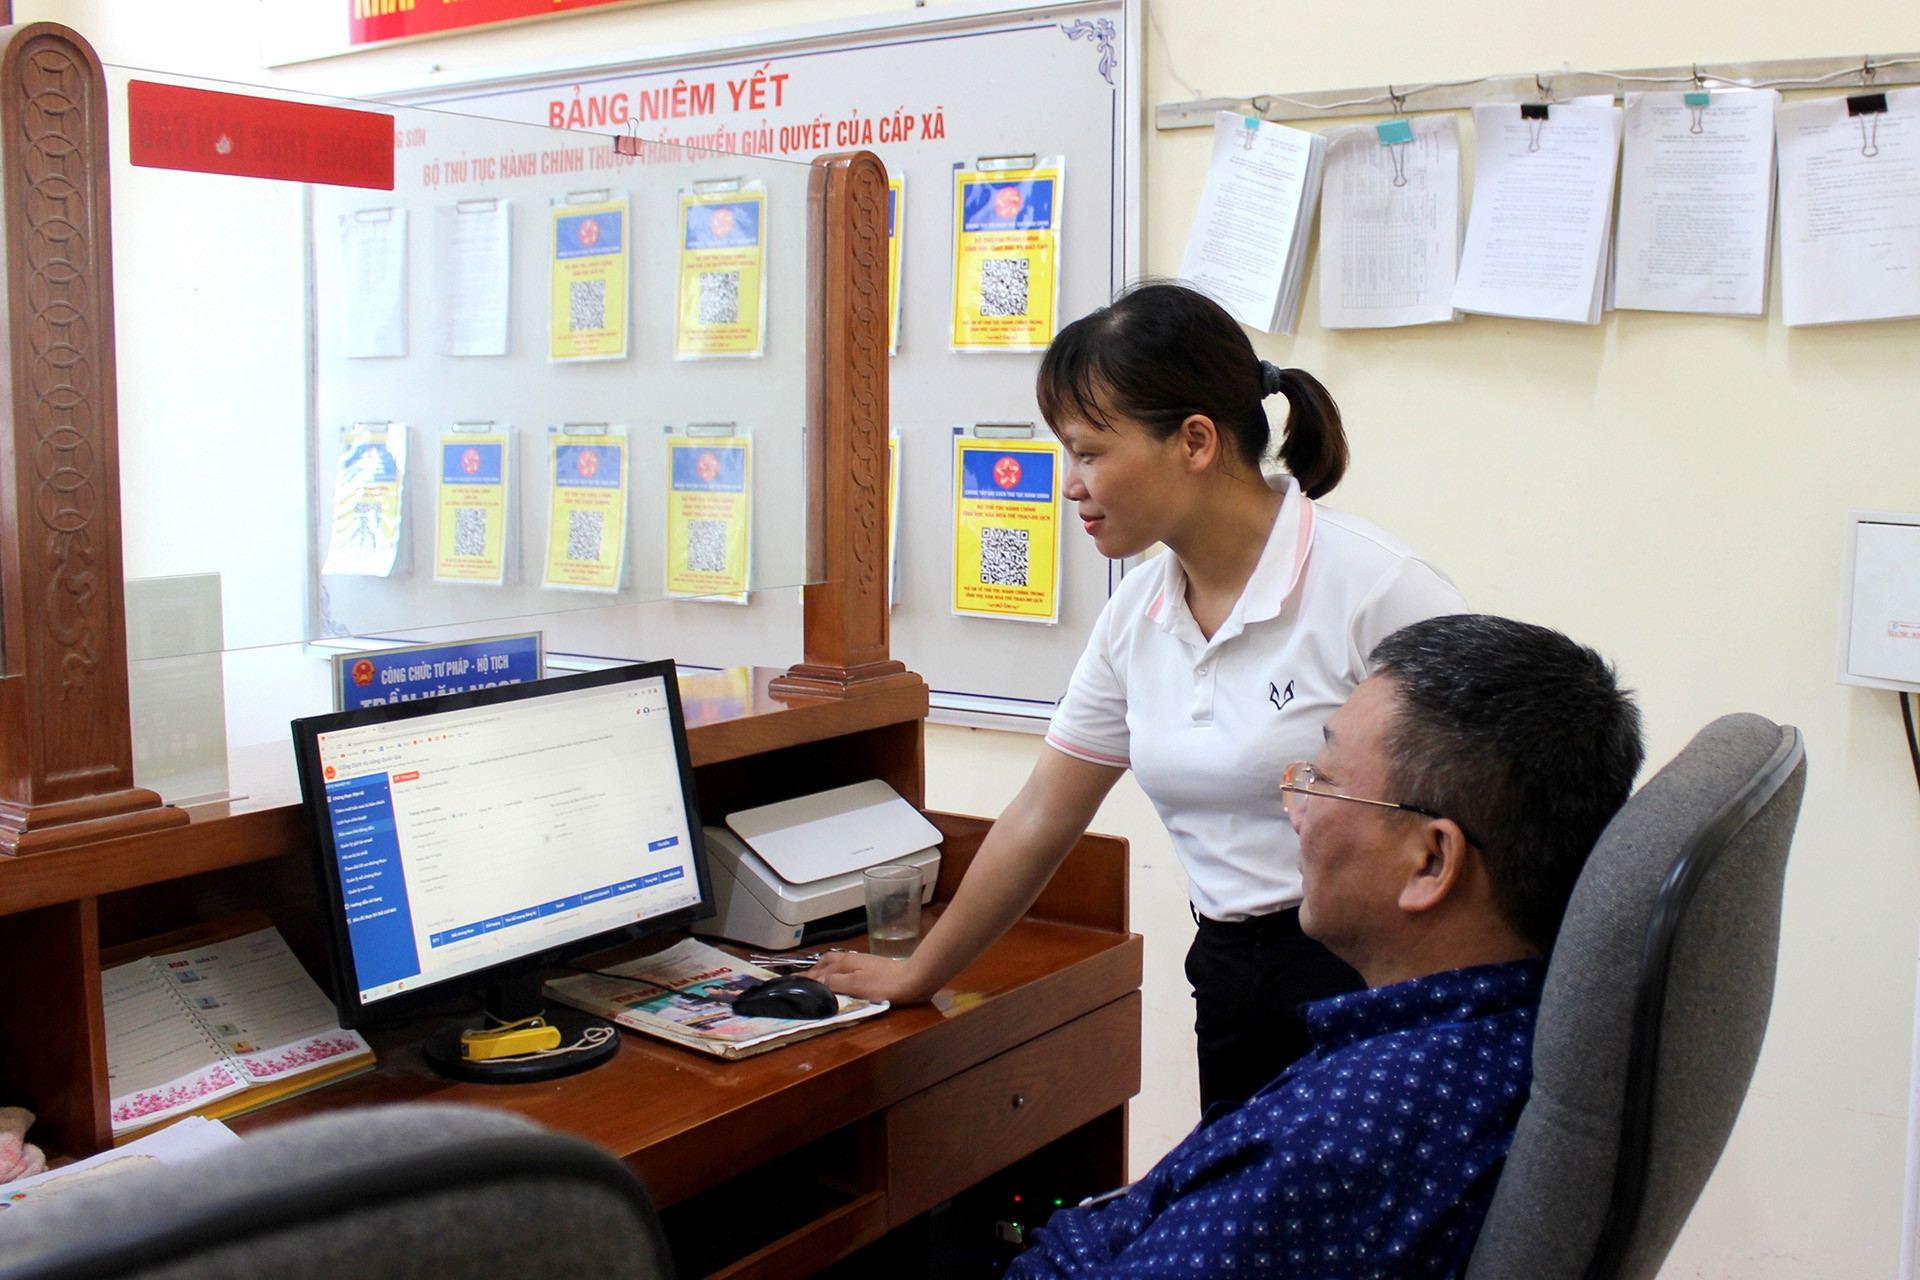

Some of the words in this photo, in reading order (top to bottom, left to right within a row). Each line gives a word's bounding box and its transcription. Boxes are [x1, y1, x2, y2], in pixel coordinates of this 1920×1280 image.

[548, 84, 630, 131] BẢNG
[638, 78, 716, 123] NIÊM
[727, 60, 791, 112] YẾT
[423, 157, 441, 190] BỘ
[444, 151, 468, 184] THỦ
[472, 157, 496, 186] TỤC
[500, 149, 537, 178] HÀNH
[541, 143, 585, 175] CHÍNH
[685, 123, 737, 163] QUYỀN
[741, 118, 775, 155] GIẢI
[778, 113, 832, 156] QUYẾT
[836, 108, 874, 147] CỦA
[878, 104, 916, 144] CẤP
[920, 105, 946, 140] XÃ
[381, 665, 406, 685] CÔNG
[408, 661, 433, 682] CHỨC
[433, 661, 446, 678] TƯ
[446, 656, 469, 676] PHÁP
[476, 655, 488, 676] HỘ
[491, 654, 509, 673] TỊCH
